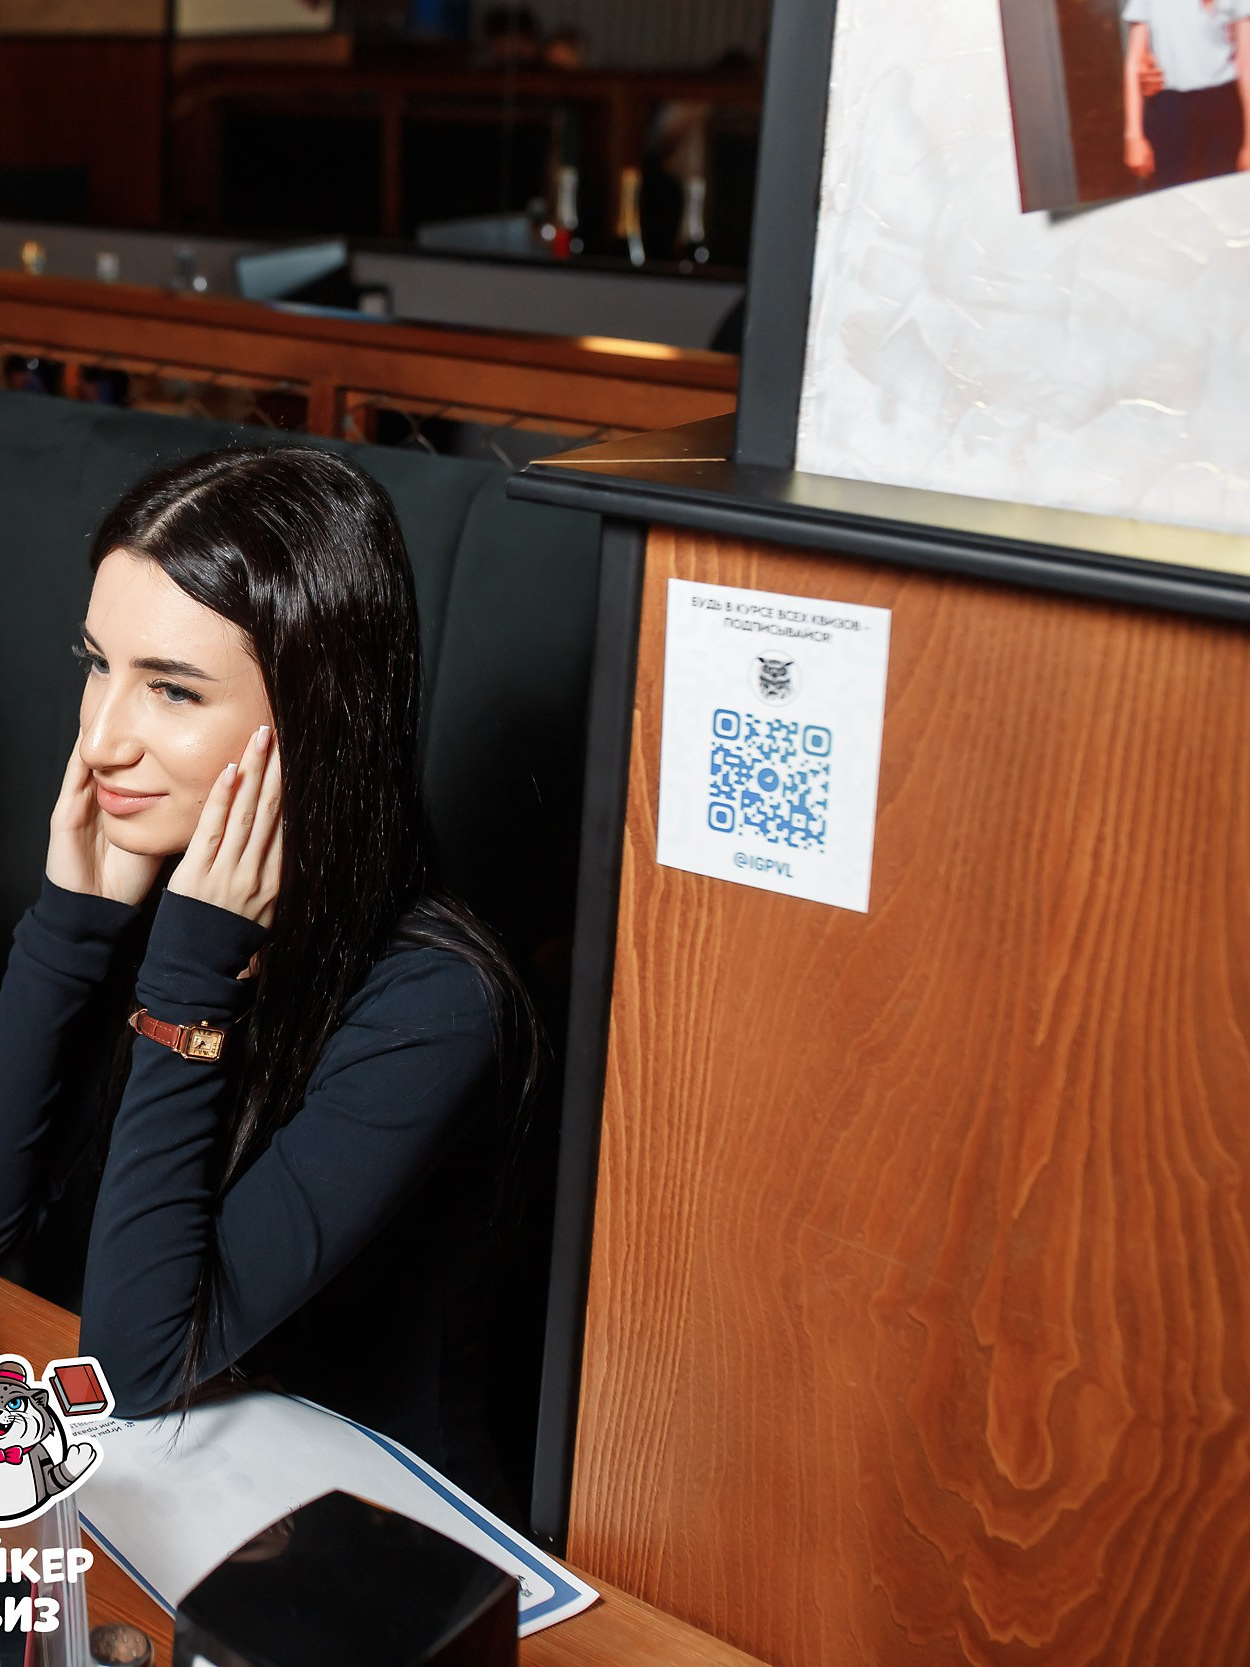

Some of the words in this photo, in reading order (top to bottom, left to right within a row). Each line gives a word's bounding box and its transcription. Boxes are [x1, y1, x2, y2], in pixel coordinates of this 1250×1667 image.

[737, 603, 774, 618] КУРСЕ
[812, 615, 861, 631] КВИЗОВ
[733, 852, 793, 878] @IGPVL
